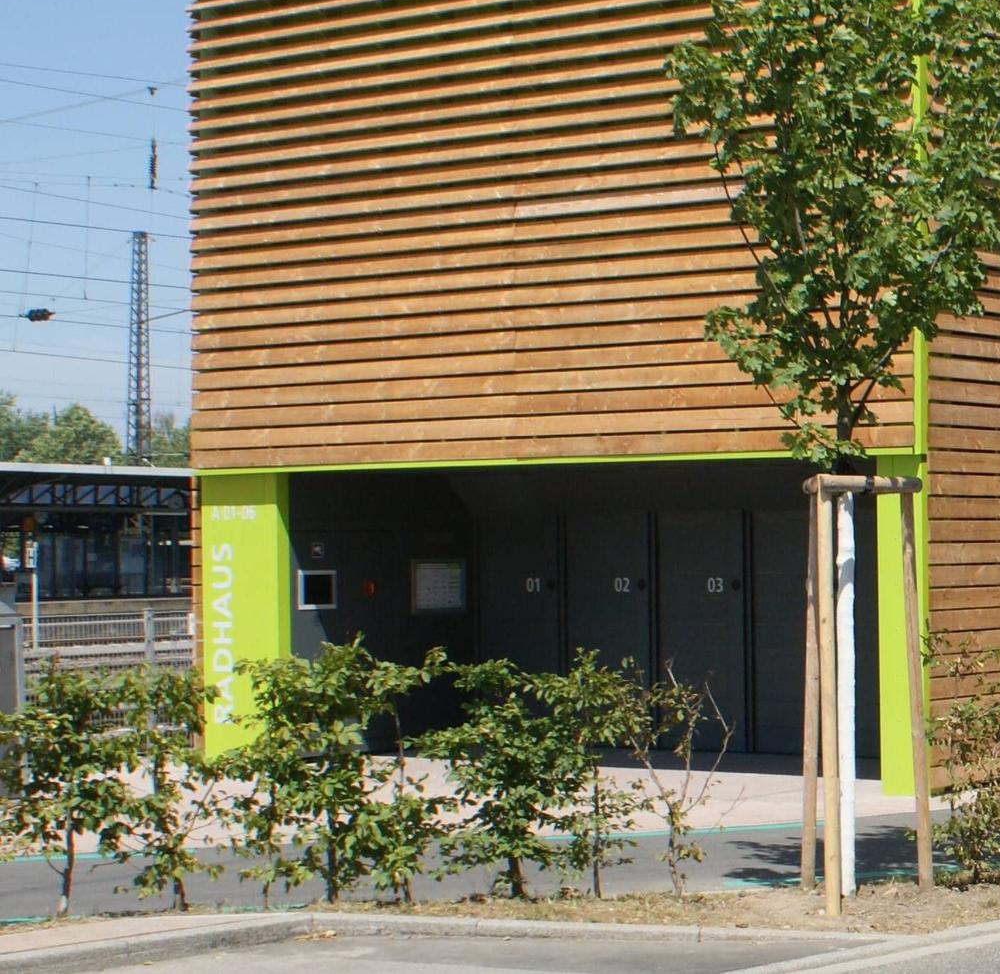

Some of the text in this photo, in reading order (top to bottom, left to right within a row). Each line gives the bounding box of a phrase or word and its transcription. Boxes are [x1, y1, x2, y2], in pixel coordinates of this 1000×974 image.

[525, 577, 541, 593] 01
[614, 577, 631, 593] 02
[707, 577, 724, 593] 03
[211, 542, 234, 726] RADHAUS
